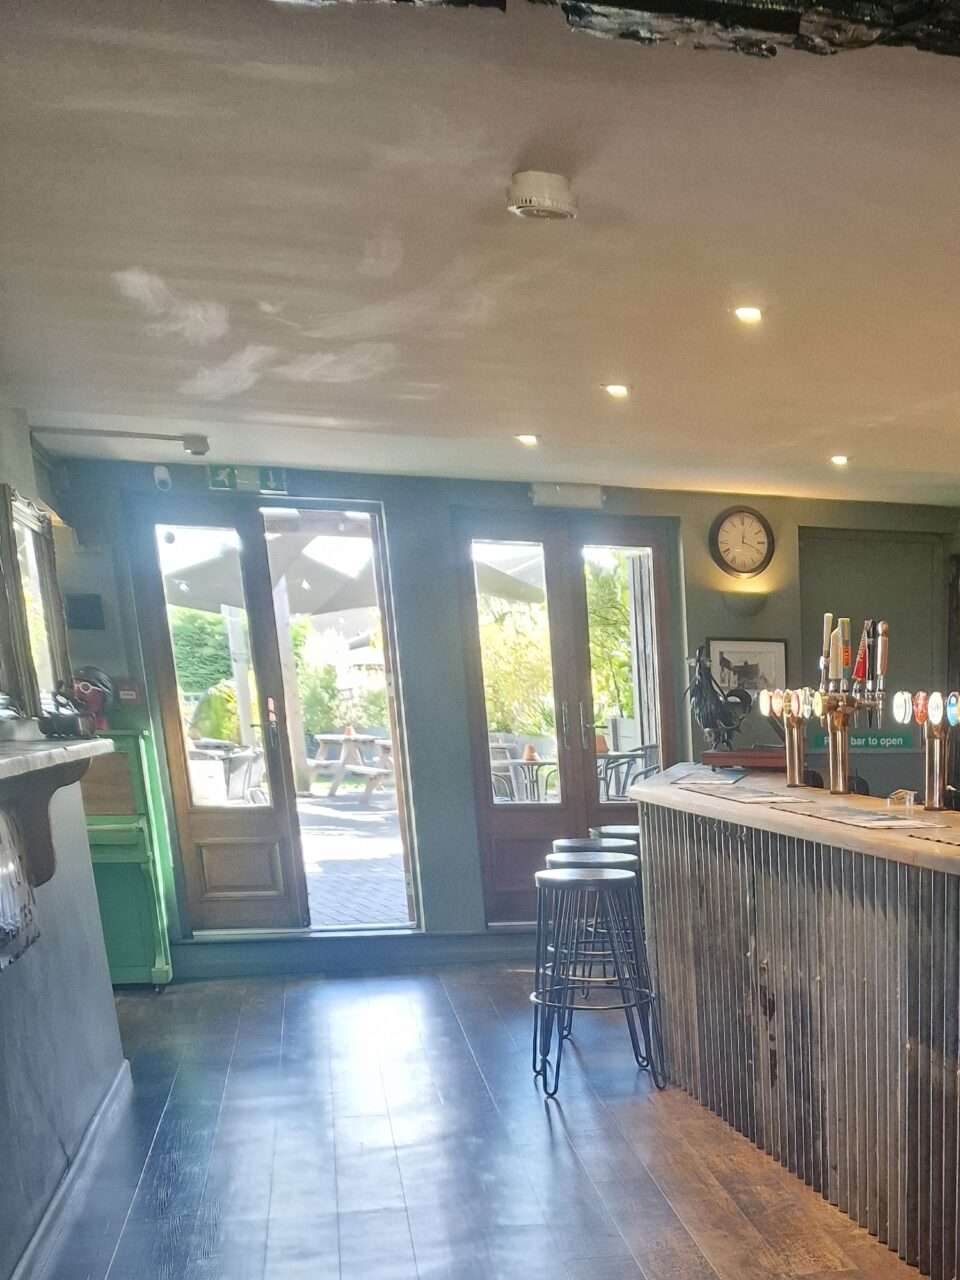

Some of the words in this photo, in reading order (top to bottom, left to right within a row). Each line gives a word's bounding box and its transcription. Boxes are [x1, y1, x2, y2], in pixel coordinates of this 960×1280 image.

[850, 736, 866, 746] bar
[868, 736, 878, 746] to
[879, 737, 903, 748] open
